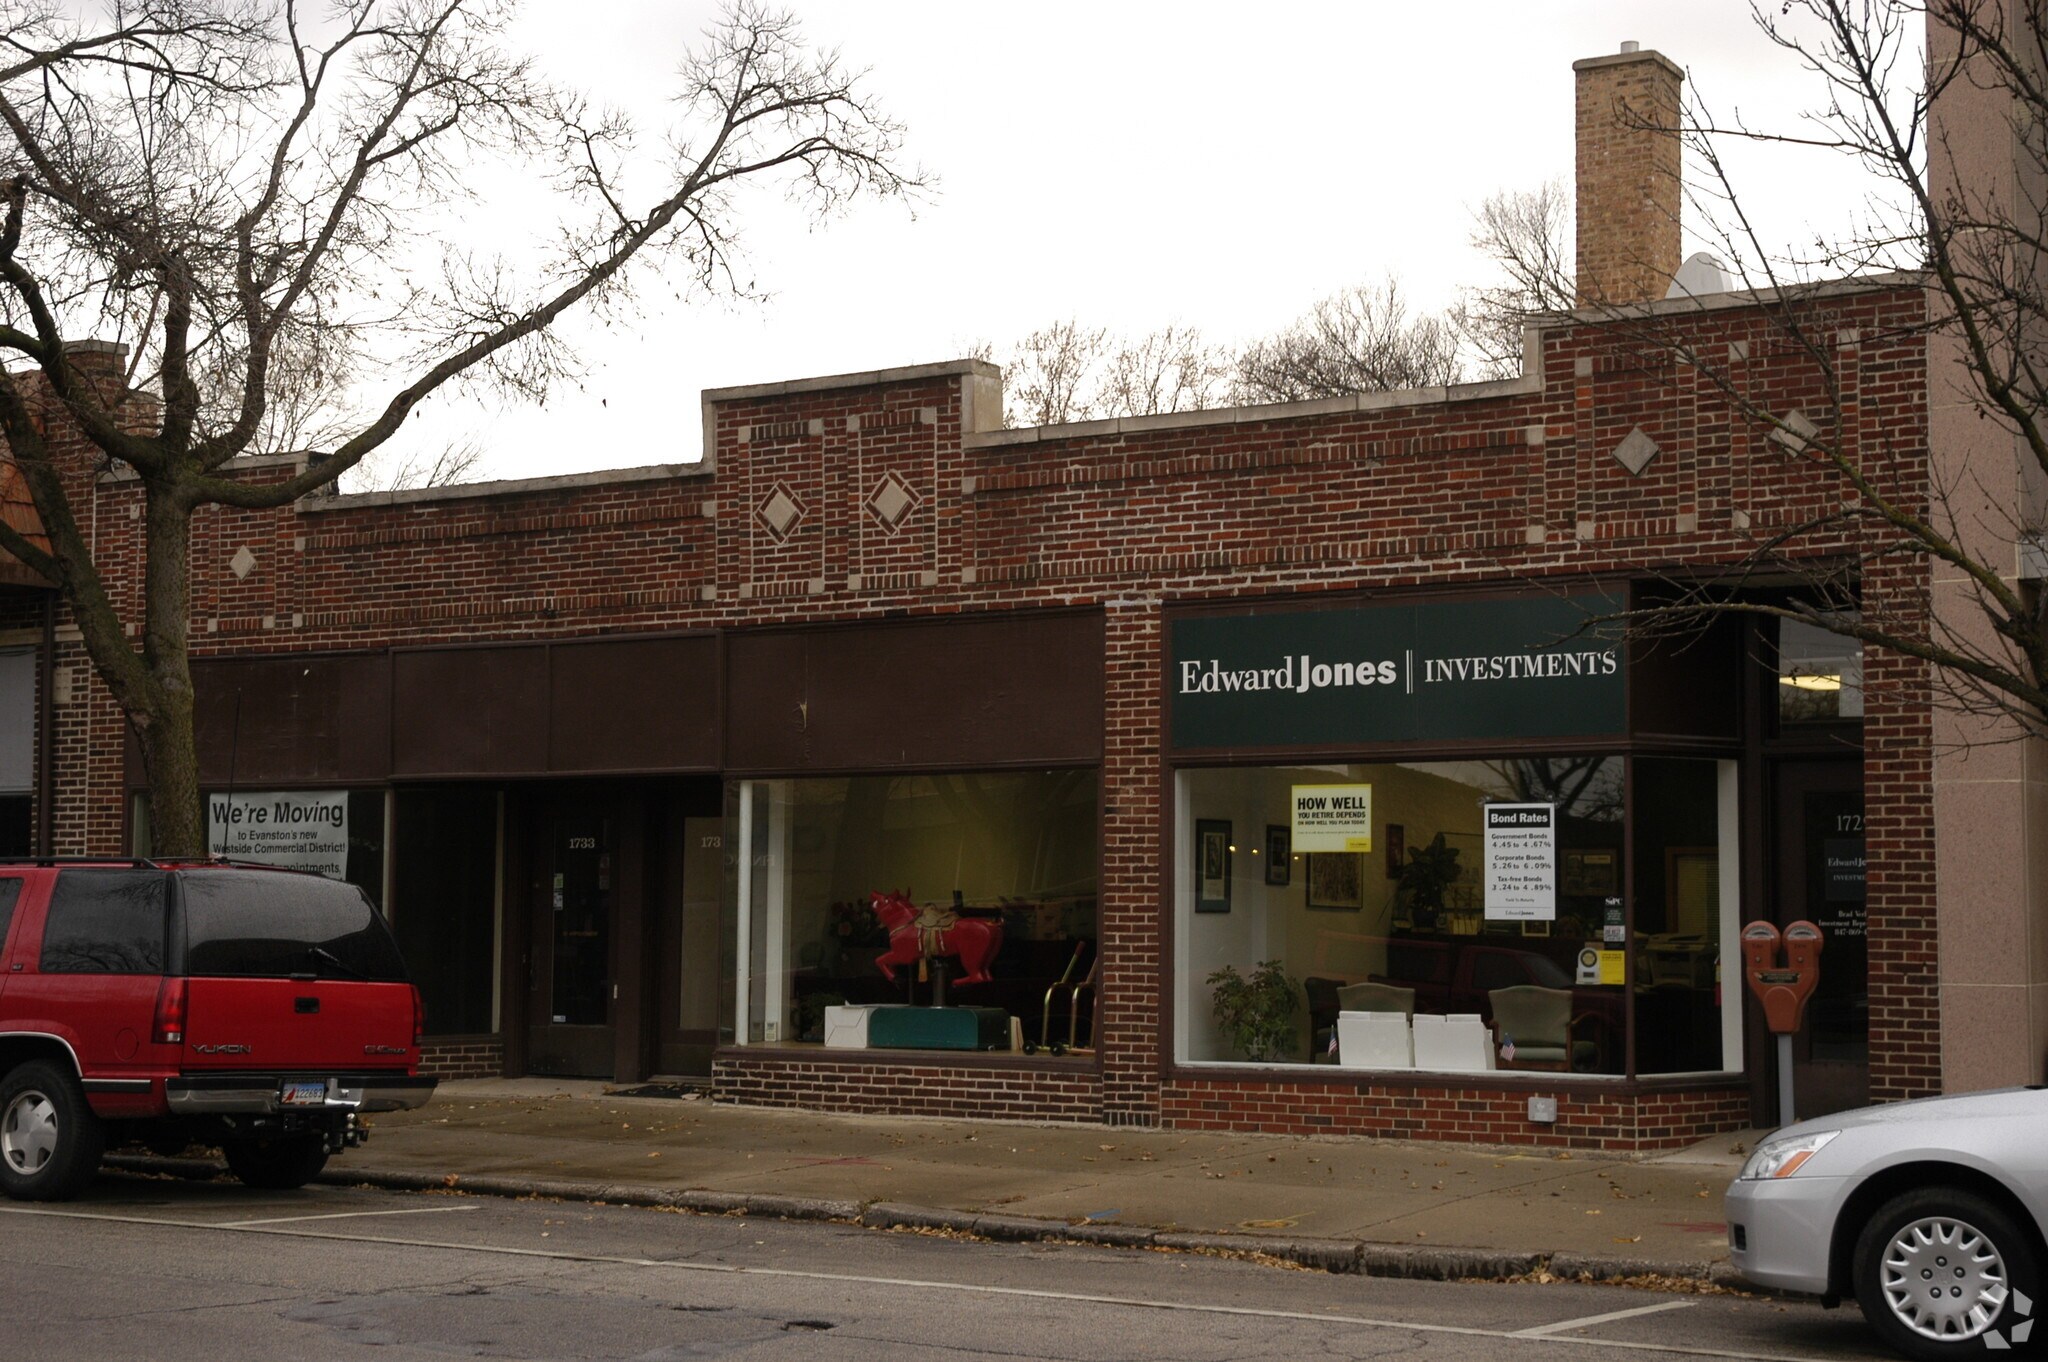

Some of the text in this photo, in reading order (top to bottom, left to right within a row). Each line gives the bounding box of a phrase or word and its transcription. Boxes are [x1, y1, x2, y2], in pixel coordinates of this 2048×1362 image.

[1424, 650, 1617, 683] INVESTMENTS
[1297, 797, 1366, 810] HOW WELL
[212, 801, 344, 828] We're Moving
[1311, 811, 1334, 819] RETIRE
[1335, 811, 1366, 819] DEPENDS
[1490, 812, 1548, 824] Bond Rates
[237, 830, 319, 840] to Evanston's new
[213, 842, 346, 854] Westside Commercial District!
[569, 837, 596, 849] 1733
[1494, 854, 1525, 862] Corporate
[192, 1044, 252, 1054] YUKON
